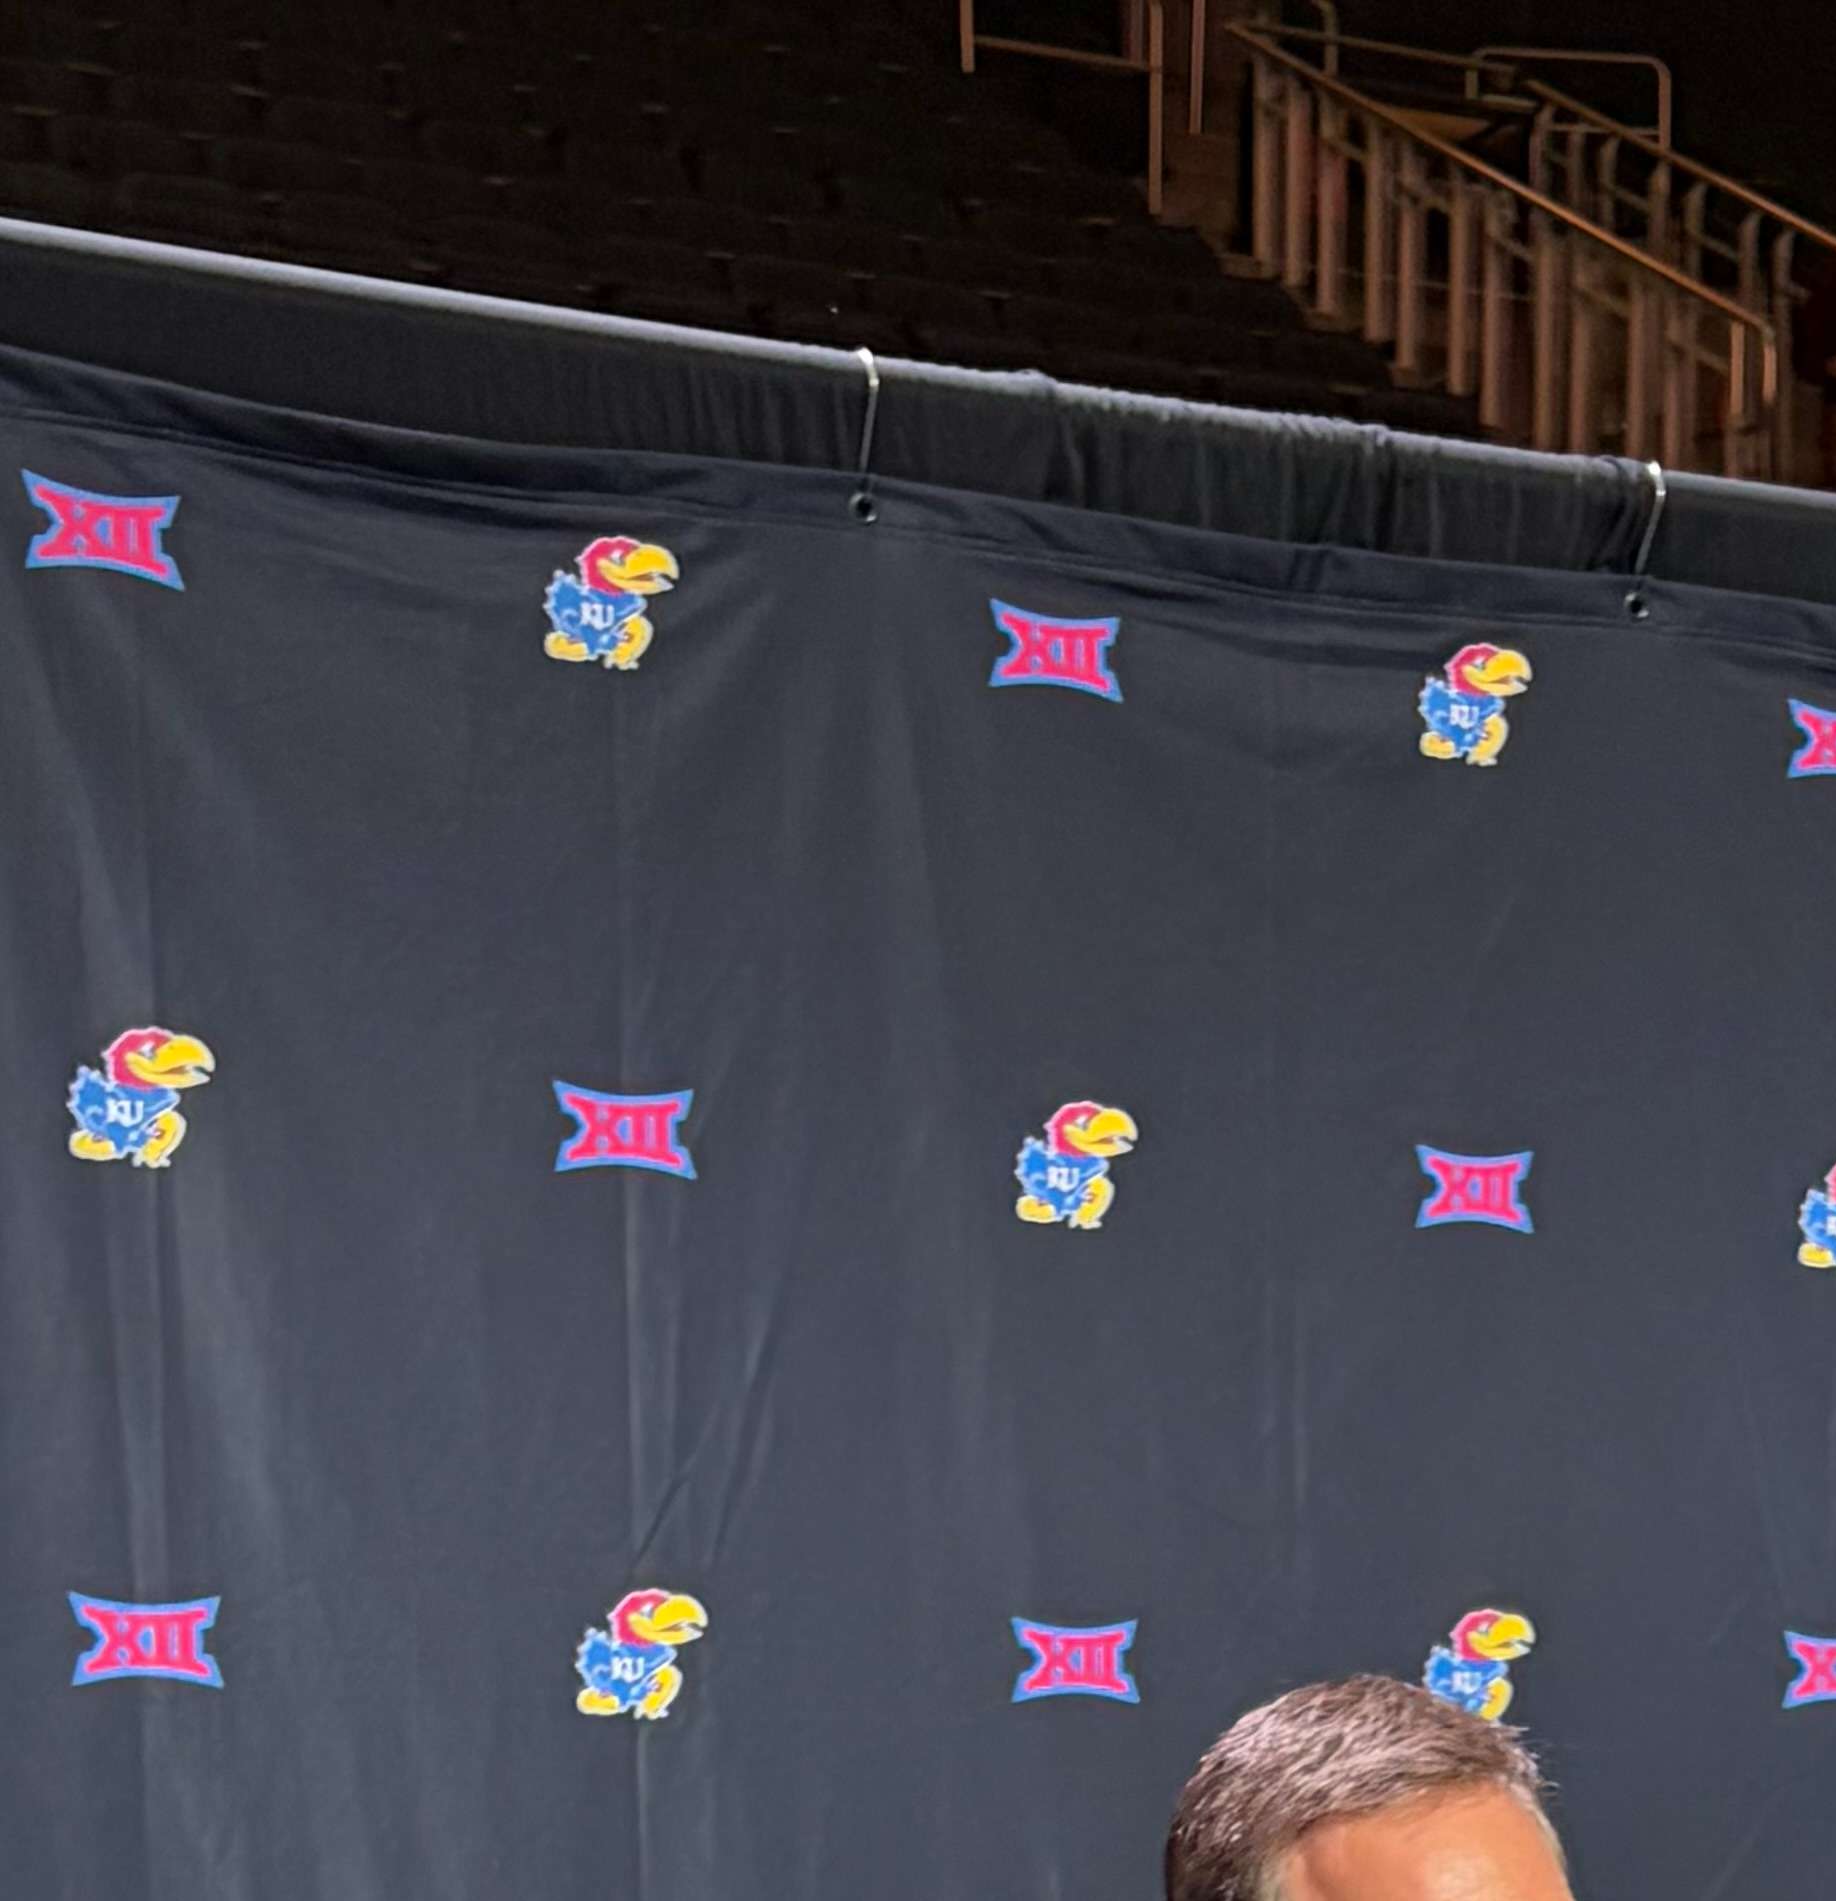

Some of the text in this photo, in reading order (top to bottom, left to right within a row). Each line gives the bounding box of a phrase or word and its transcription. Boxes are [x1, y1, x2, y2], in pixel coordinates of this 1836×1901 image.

[33, 482, 170, 580] XII
[579, 601, 616, 631] KU
[998, 609, 1112, 693] XII
[104, 1099, 144, 1126] KU
[563, 1091, 684, 1169] XII
[1425, 1154, 1523, 1225] XII
[79, 1603, 212, 1679] XII
[610, 1655, 645, 1682] KU
[1021, 1626, 1129, 1696] XII
